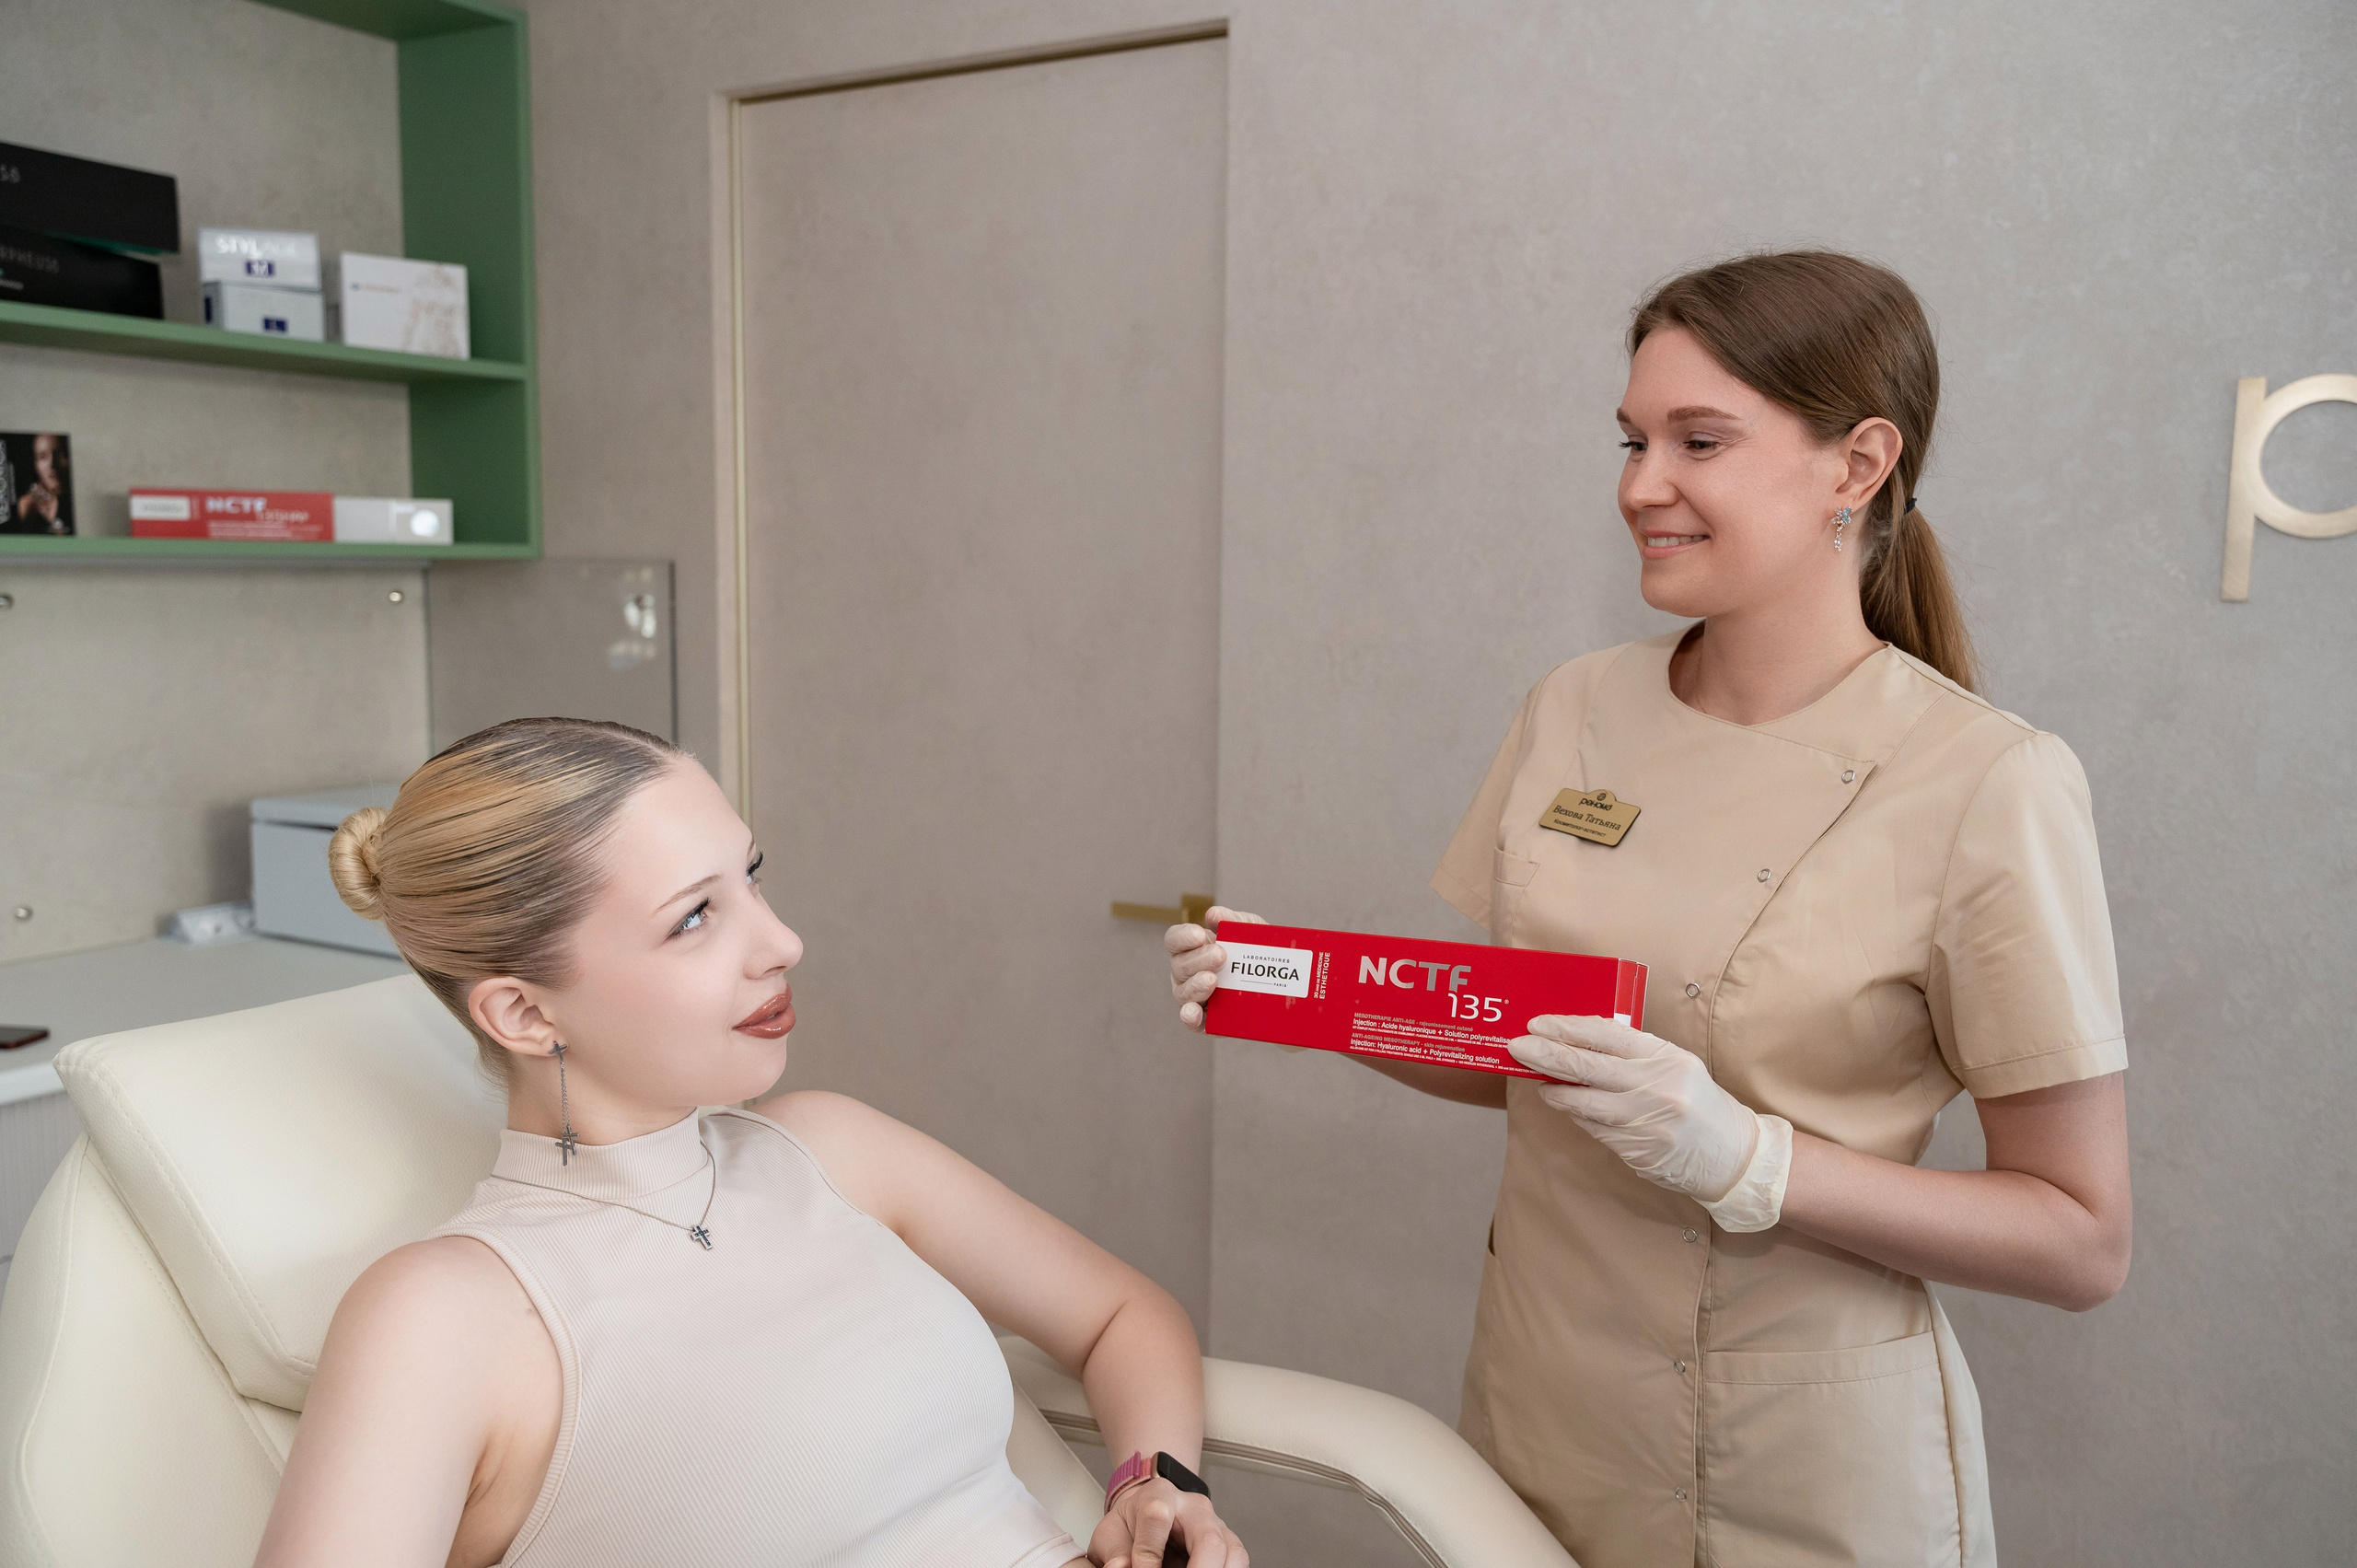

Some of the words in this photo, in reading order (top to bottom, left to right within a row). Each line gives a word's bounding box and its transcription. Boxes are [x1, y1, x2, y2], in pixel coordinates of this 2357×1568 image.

[1553, 805, 1584, 820] Вехова
[1585, 813, 1621, 830] Татьяна
[1243, 955, 1290, 964] LABORATOIRES
[1231, 961, 1299, 981] FILORGA
[1318, 952, 1330, 999] ESTHETIQUE
[1354, 1012, 1392, 1022] MESOTHERAPIE
[1353, 1018, 1376, 1028] Injection
[1399, 1024, 1436, 1036] hyaluronique
[1444, 1029, 1469, 1039] Solution
[1352, 1032, 1382, 1041] ANTI-AGEING
[1384, 1036, 1421, 1046] MESOTHERAPY
[1351, 1039, 1376, 1048] Injection:
[1376, 1041, 1408, 1051] Hyaluronic
[1429, 1050, 1473, 1062] Polyrevitalizing
[1475, 1055, 1500, 1064] solution
